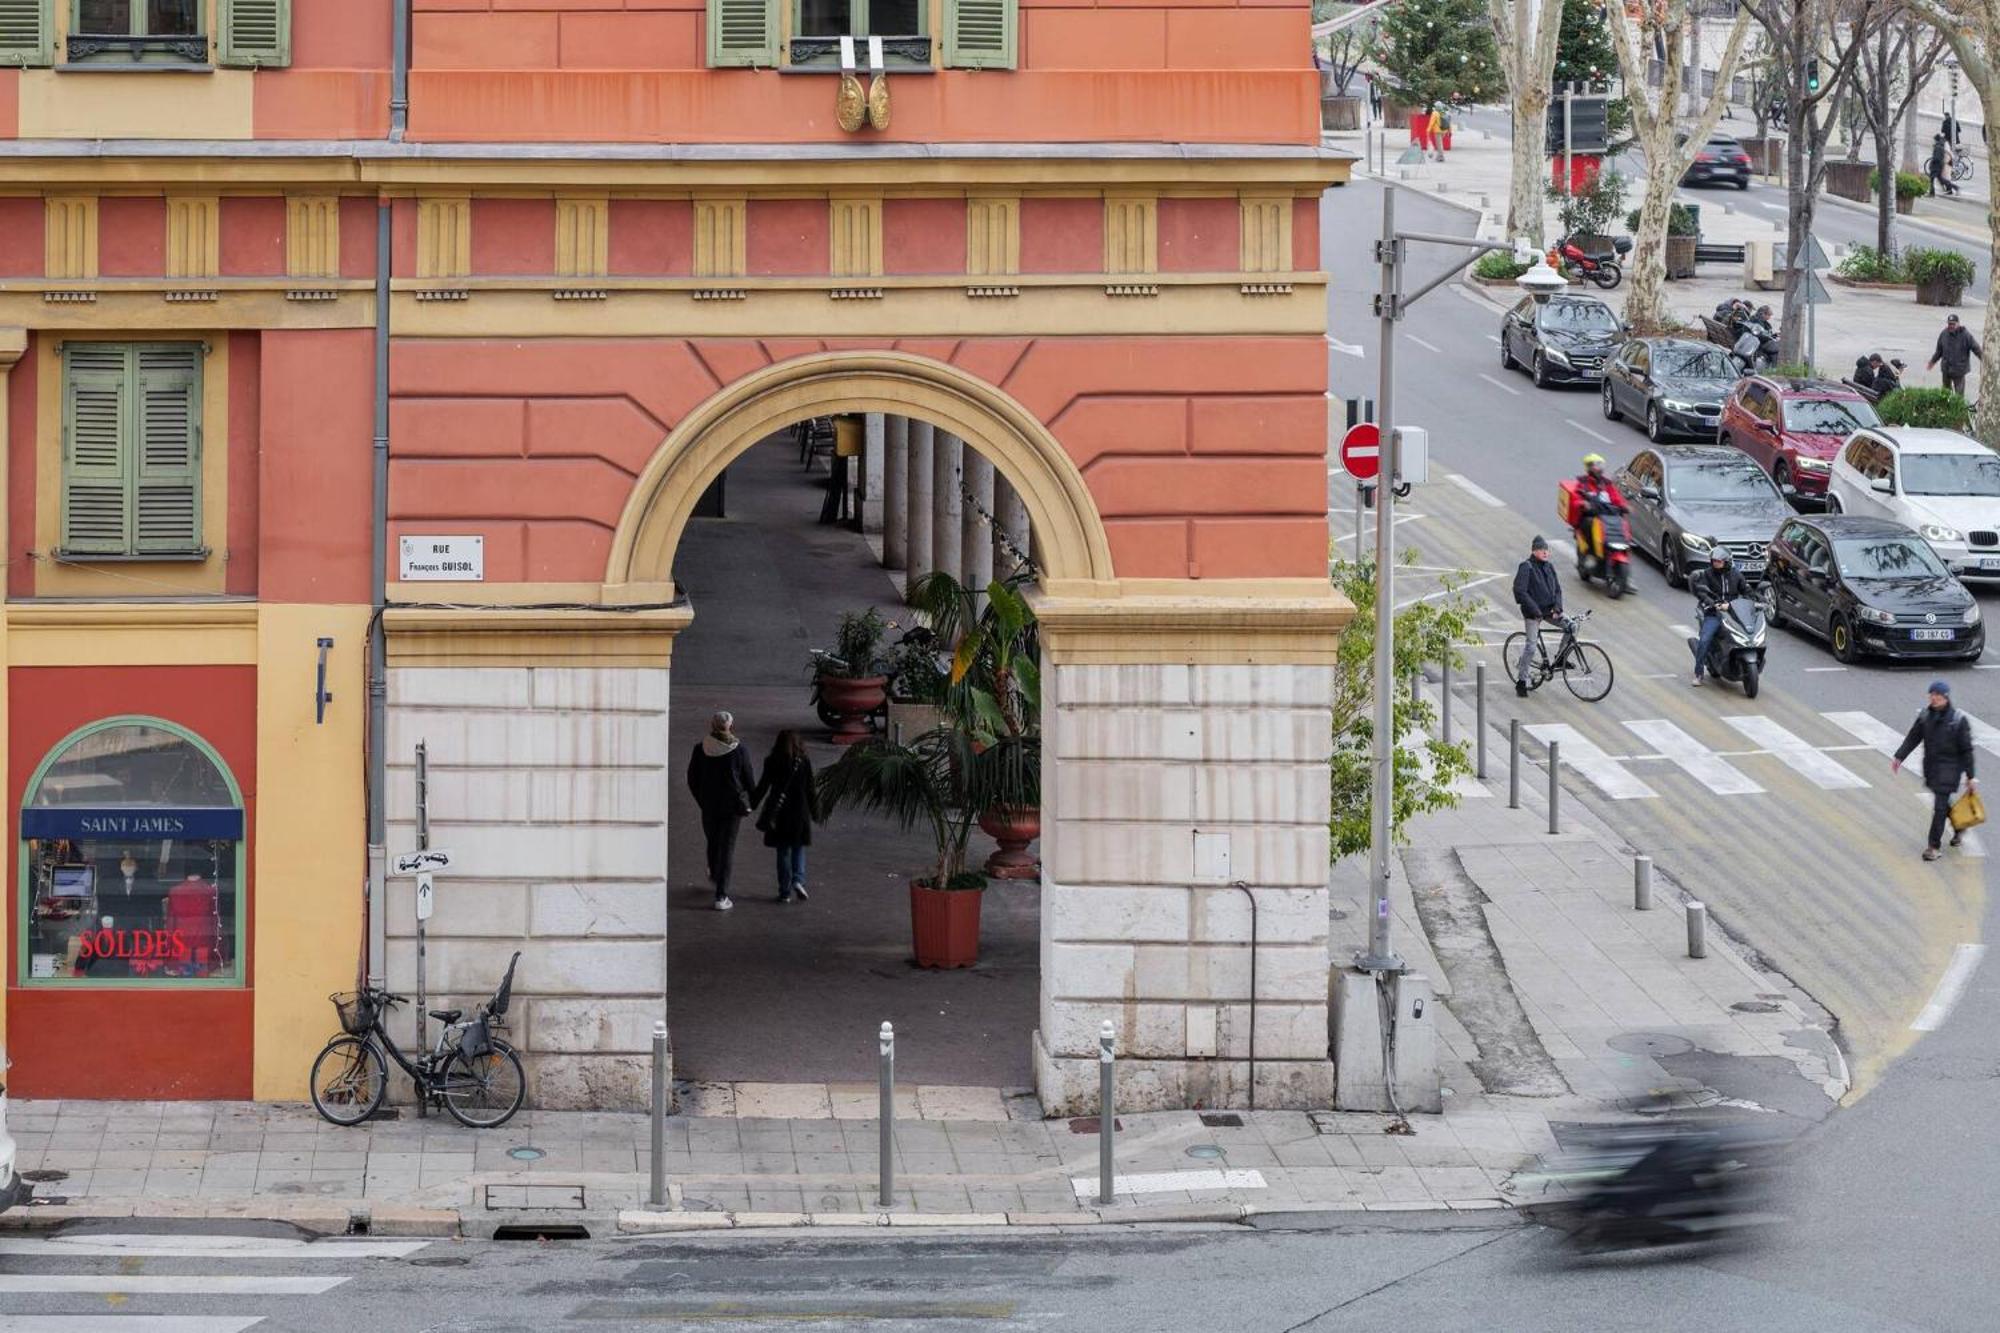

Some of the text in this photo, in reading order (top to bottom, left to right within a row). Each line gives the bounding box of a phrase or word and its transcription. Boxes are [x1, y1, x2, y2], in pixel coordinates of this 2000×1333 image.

[433, 544, 450, 553] RUE
[442, 562, 473, 571] GUISOL
[80, 817, 184, 832] SAINT JAMES
[79, 929, 186, 958] SOLDES
